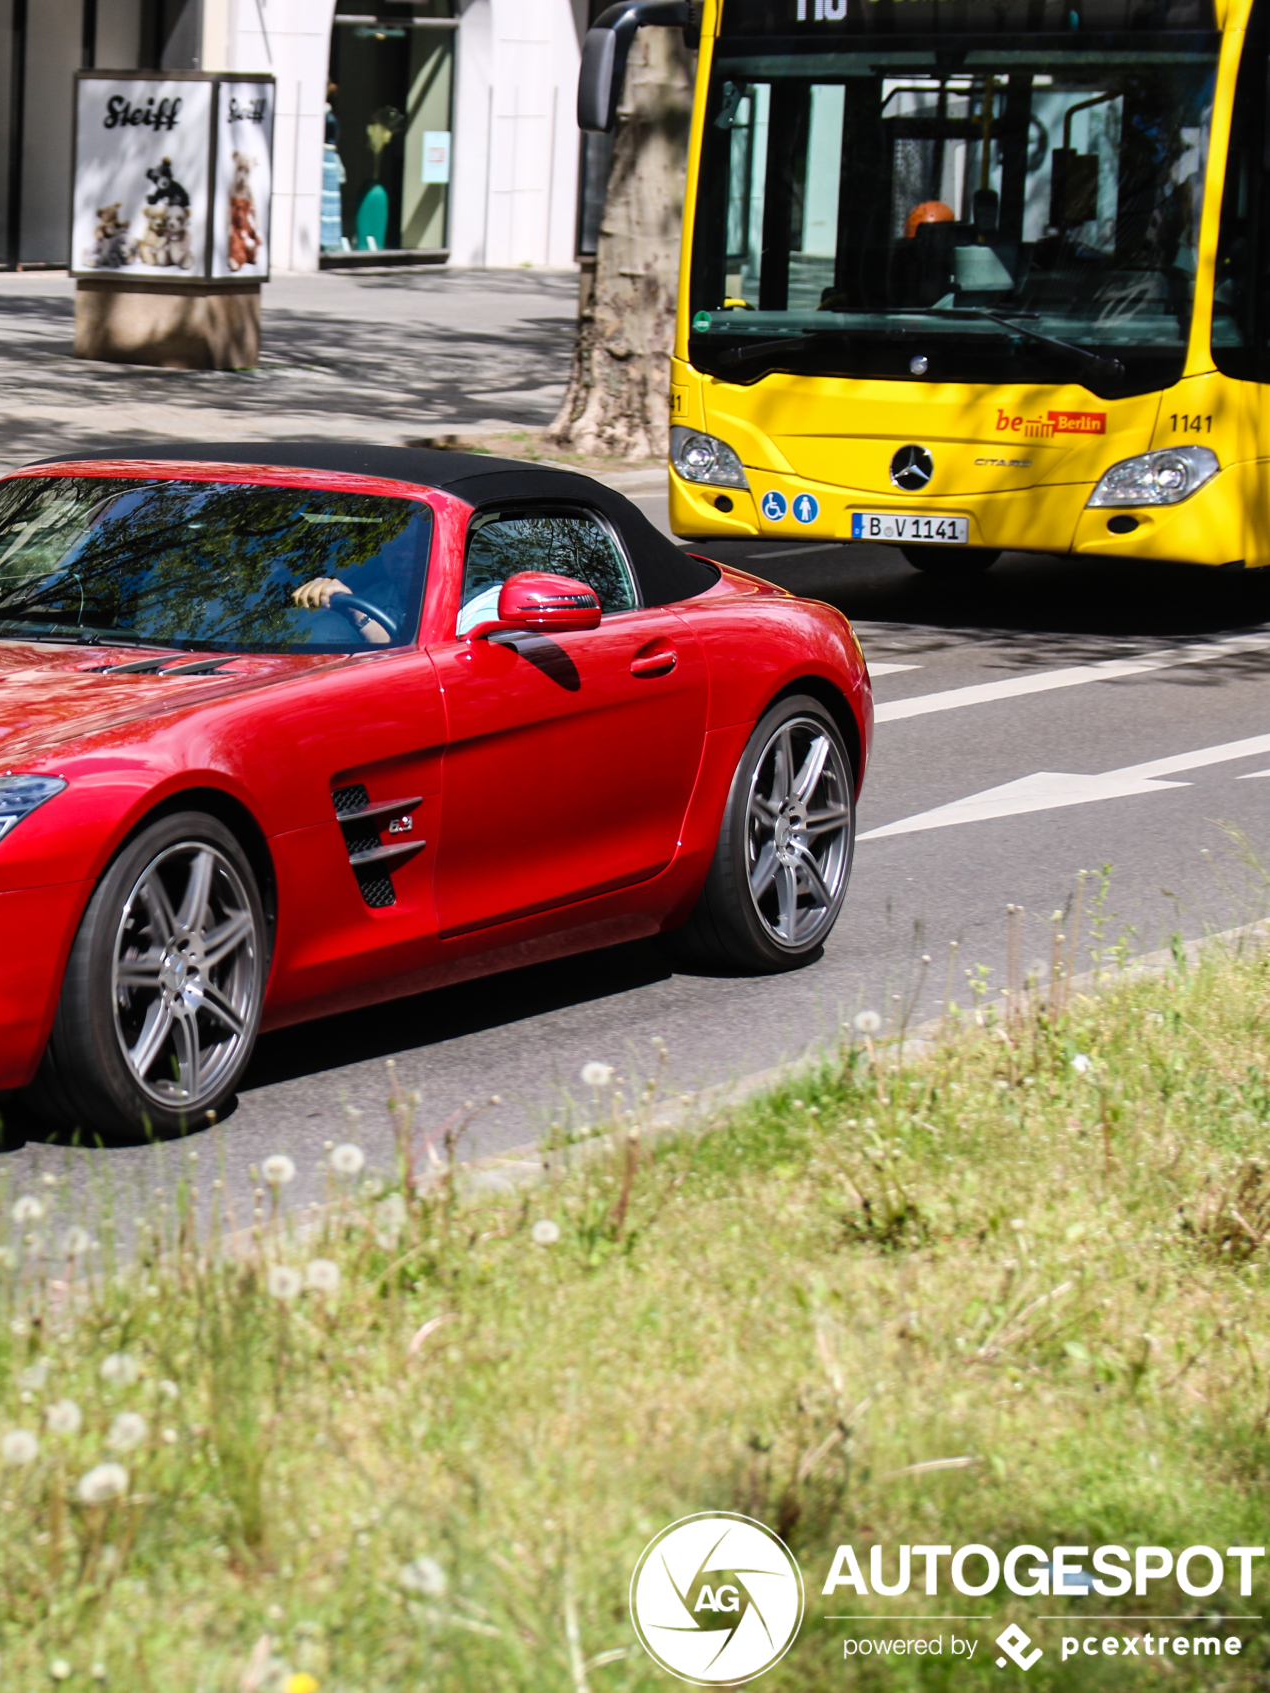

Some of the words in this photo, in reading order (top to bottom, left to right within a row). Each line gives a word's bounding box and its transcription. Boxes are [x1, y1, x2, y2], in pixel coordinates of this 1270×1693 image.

[104, 94, 183, 131] Steiff
[227, 97, 266, 124] Steiff
[995, 409, 1023, 432] be
[1057, 415, 1102, 431] Berlin
[1169, 413, 1213, 434] 1141
[974, 457, 1033, 468] CITARO
[870, 517, 882, 536] B
[895, 518, 907, 537] V
[912, 519, 959, 540] 1141
[389, 816, 413, 834] 6.3
